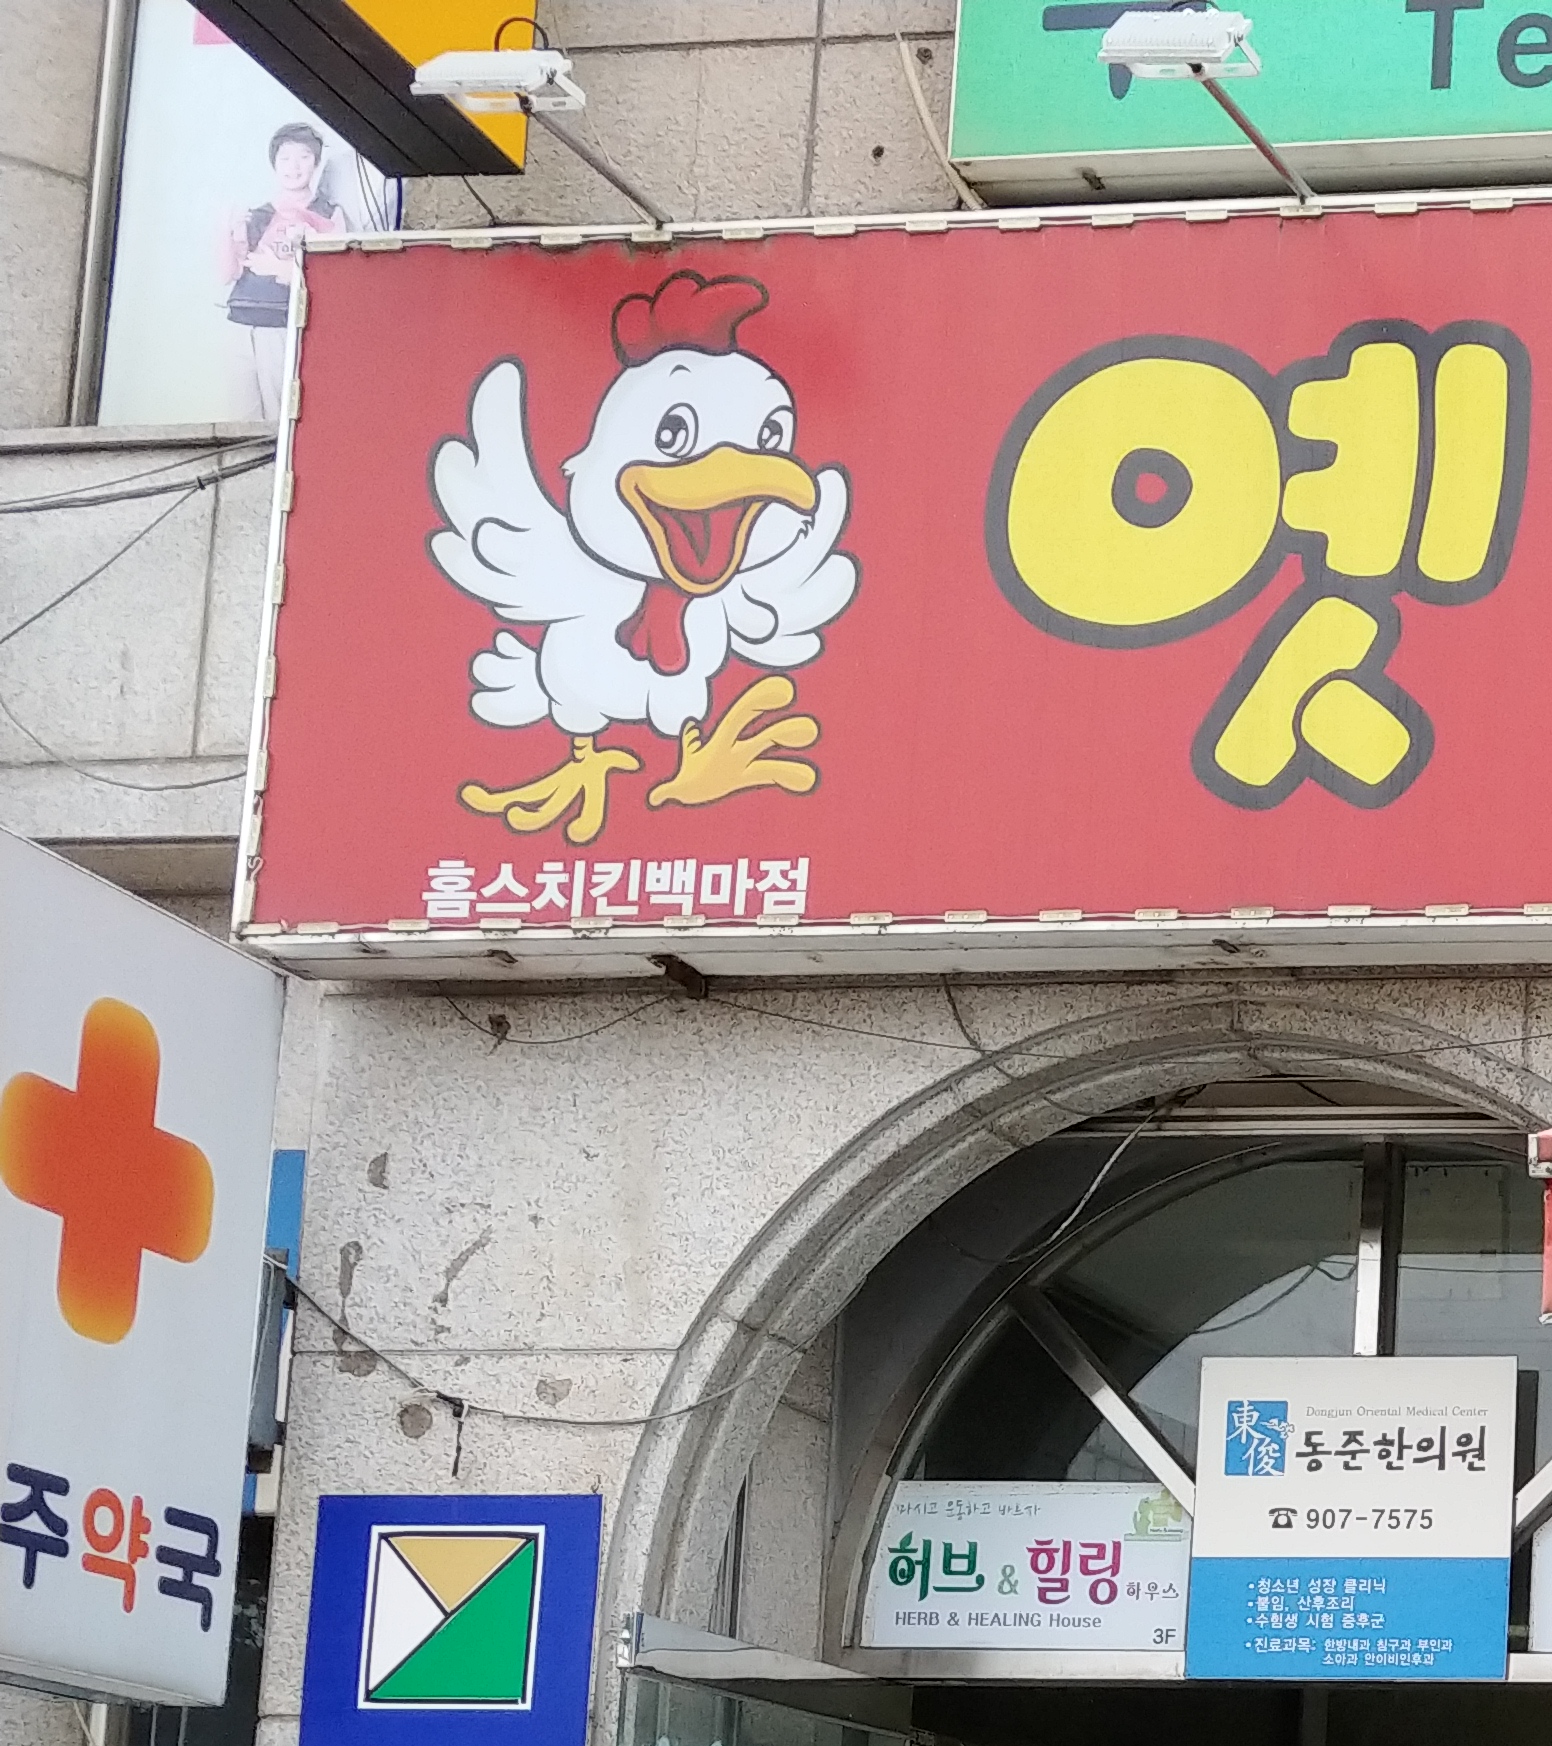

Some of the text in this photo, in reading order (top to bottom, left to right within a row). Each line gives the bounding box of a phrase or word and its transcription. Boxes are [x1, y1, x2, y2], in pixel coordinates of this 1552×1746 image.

[422, 857, 808, 918] 홈스치킨백마점
[1306, 1406, 1489, 1419] Dongjun Oriental Medical Center
[1296, 1426, 1486, 1472] 동준한의원
[1306, 1508, 1434, 1530] 907-7575
[888, 1531, 1180, 1605] 허브 & 힐링 하우스
[1257, 1578, 1386, 1594] 청소년 성장 클리닉
[1297, 1596, 1354, 1611] 산후조리
[895, 1611, 1102, 1629] HERB & HEALING House
[1255, 1613, 1386, 1629] 수험생 시험 증후군
[1152, 1628, 1177, 1644] 3F
[1324, 1638, 1371, 1652] 한방내과
[1417, 1638, 1453, 1652] 부인과
[1323, 1653, 1359, 1666] 소아과
